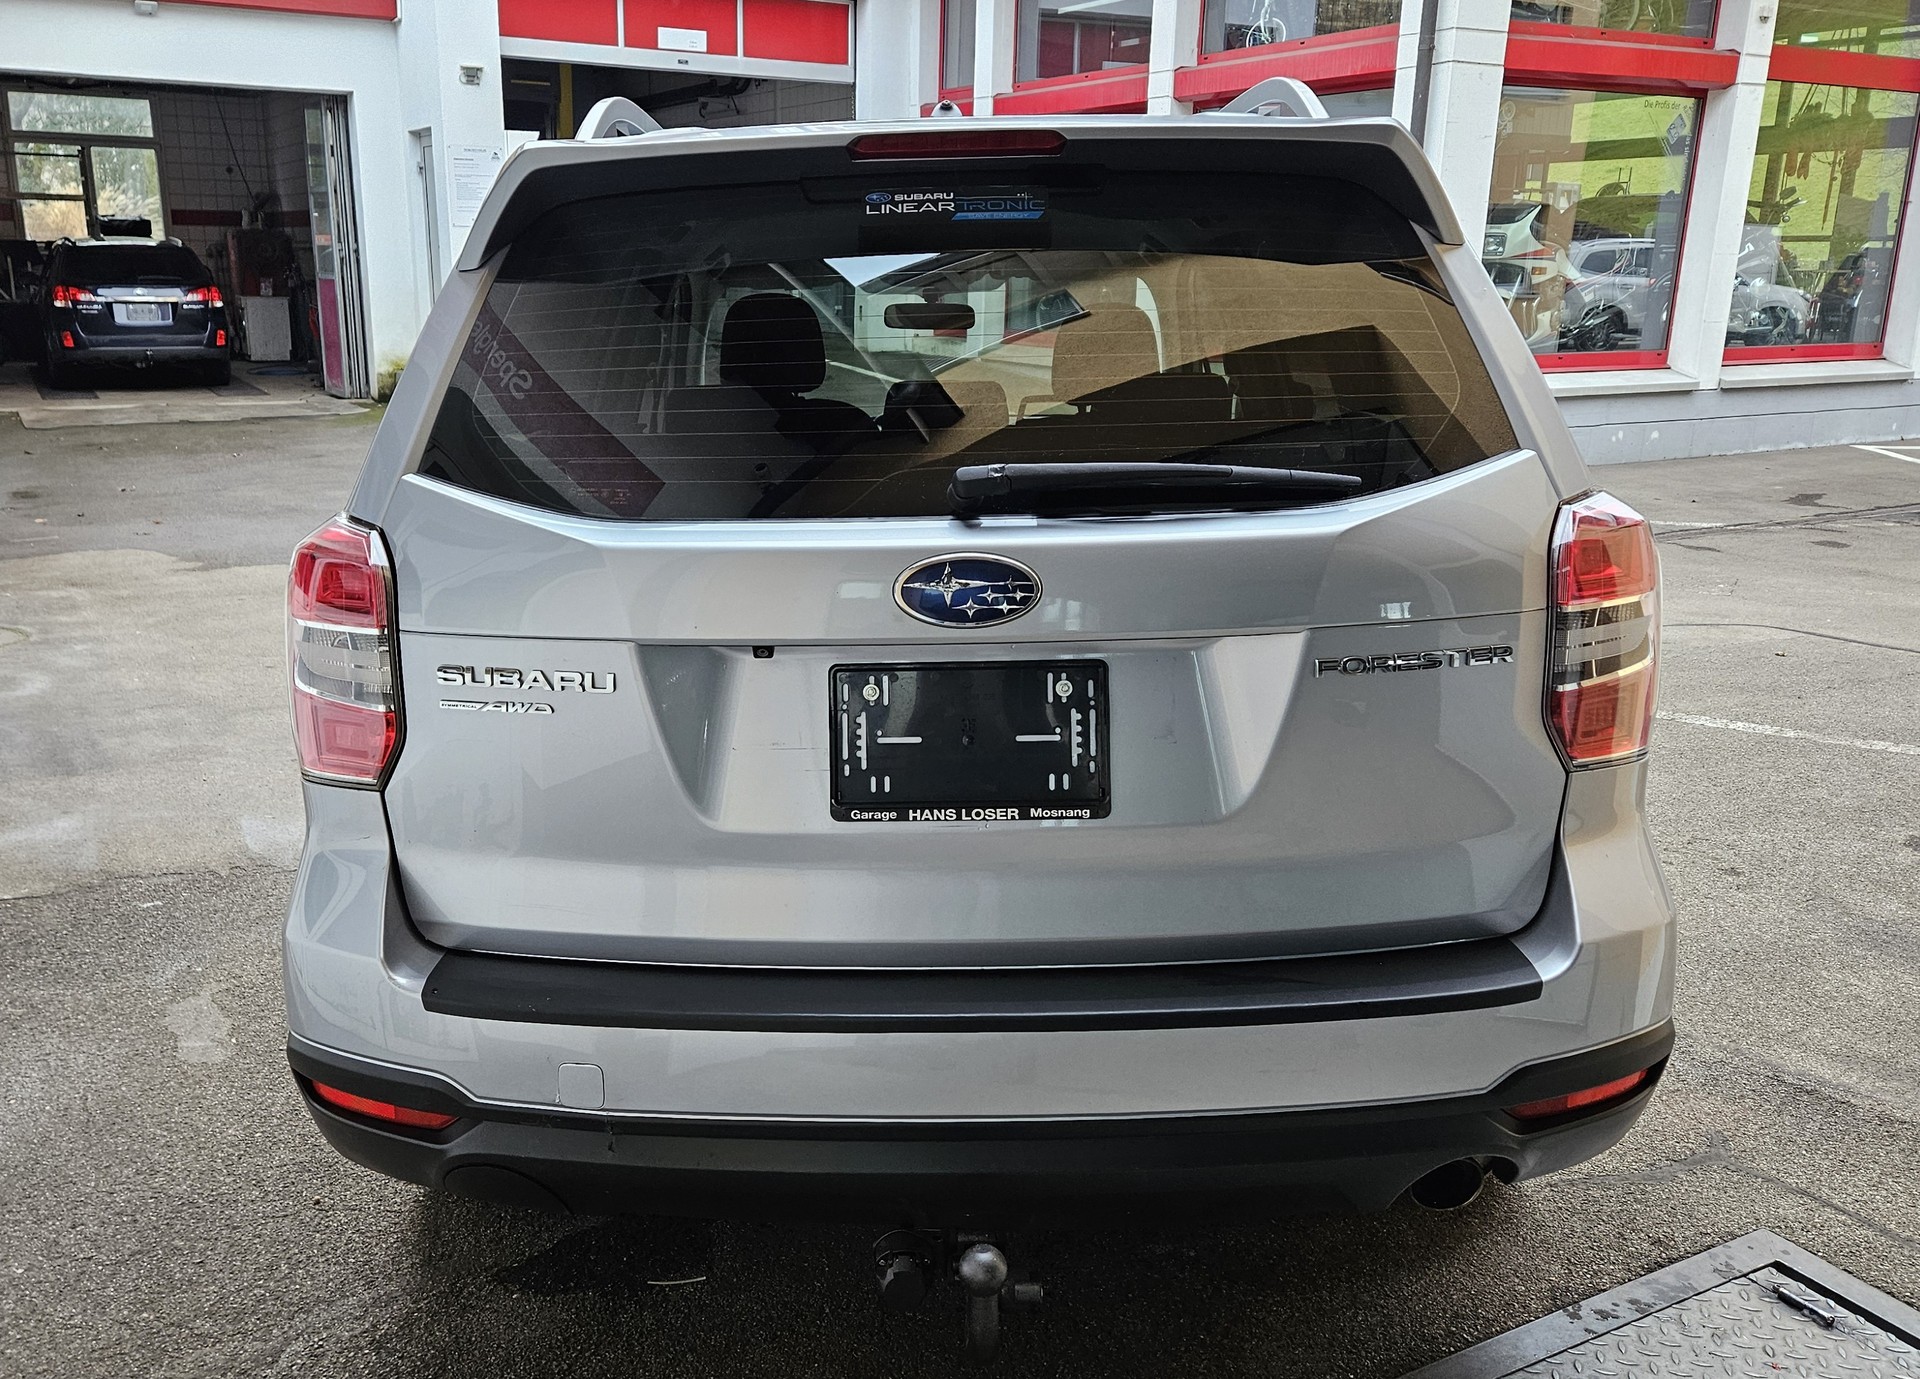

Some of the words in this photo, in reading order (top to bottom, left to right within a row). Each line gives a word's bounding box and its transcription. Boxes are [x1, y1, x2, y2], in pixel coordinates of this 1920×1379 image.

[1644, 100, 1653, 108] Die
[1654, 100, 1670, 109] Profis
[1671, 101, 1680, 110] der
[894, 192, 954, 201] SUBARU
[1313, 644, 1514, 678] FORESTER
[436, 664, 616, 694] SUBARU
[481, 701, 554, 715] AWD
[850, 809, 898, 821] Garage
[908, 809, 957, 821] HANS
[961, 808, 1020, 821] LOSER
[1030, 807, 1091, 820] Mosnang
